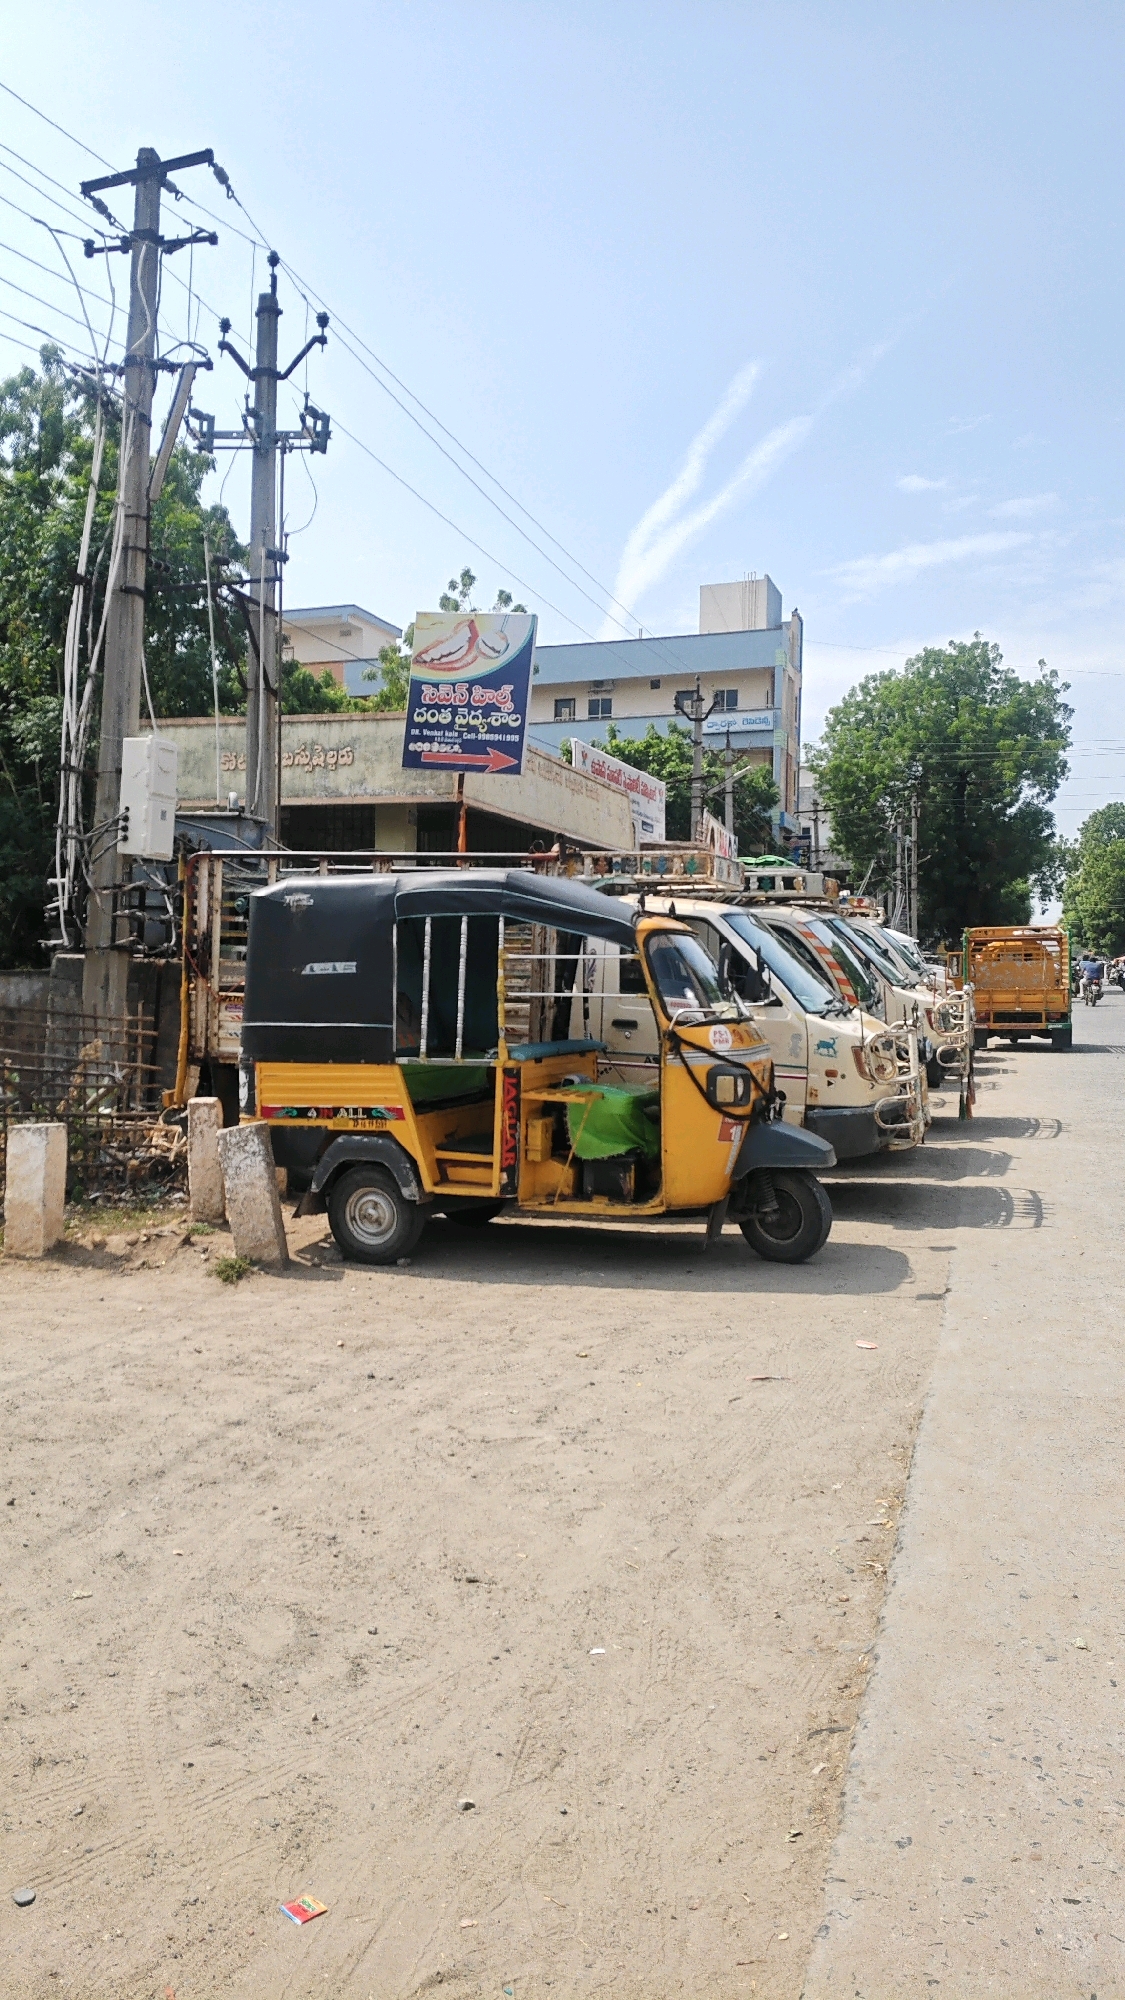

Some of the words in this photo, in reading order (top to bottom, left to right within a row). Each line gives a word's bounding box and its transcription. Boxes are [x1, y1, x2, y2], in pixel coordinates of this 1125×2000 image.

[413, 707, 452, 724] దంత
[454, 708, 521, 733] వైద్యశాల
[307, 1107, 317, 1118] 4
[320, 1108, 333, 1118] IN
[337, 1107, 366, 1118] ALL
[502, 1076, 518, 1168] JAGUAR
